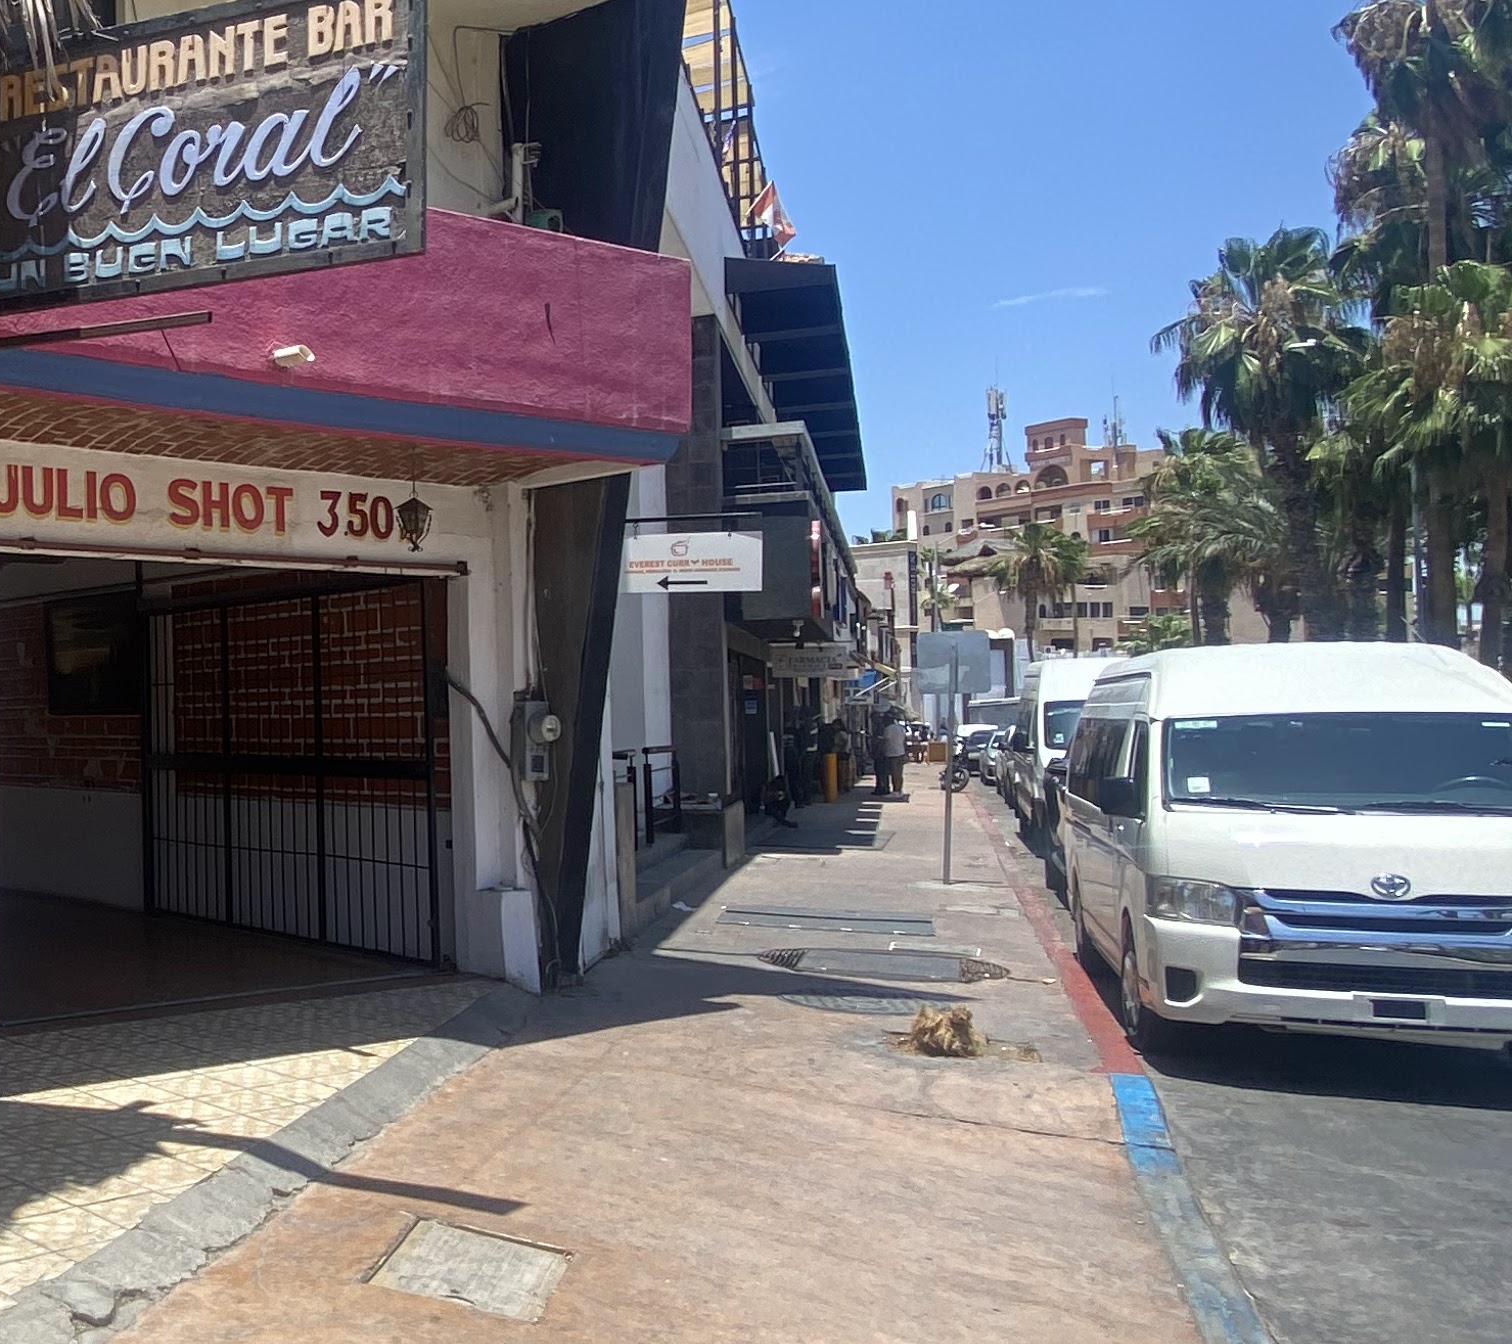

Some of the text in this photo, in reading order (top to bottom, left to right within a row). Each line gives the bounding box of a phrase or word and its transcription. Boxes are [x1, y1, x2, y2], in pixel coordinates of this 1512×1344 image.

[0, 14, 288, 123] RESTAURANTE
[64, 236, 193, 283] BUEN
[216, 206, 393, 261] LUGAR
[168, 478, 294, 536] SHOT
[628, 560, 665, 568] EVEREST
[701, 558, 734, 567] HOUSE
